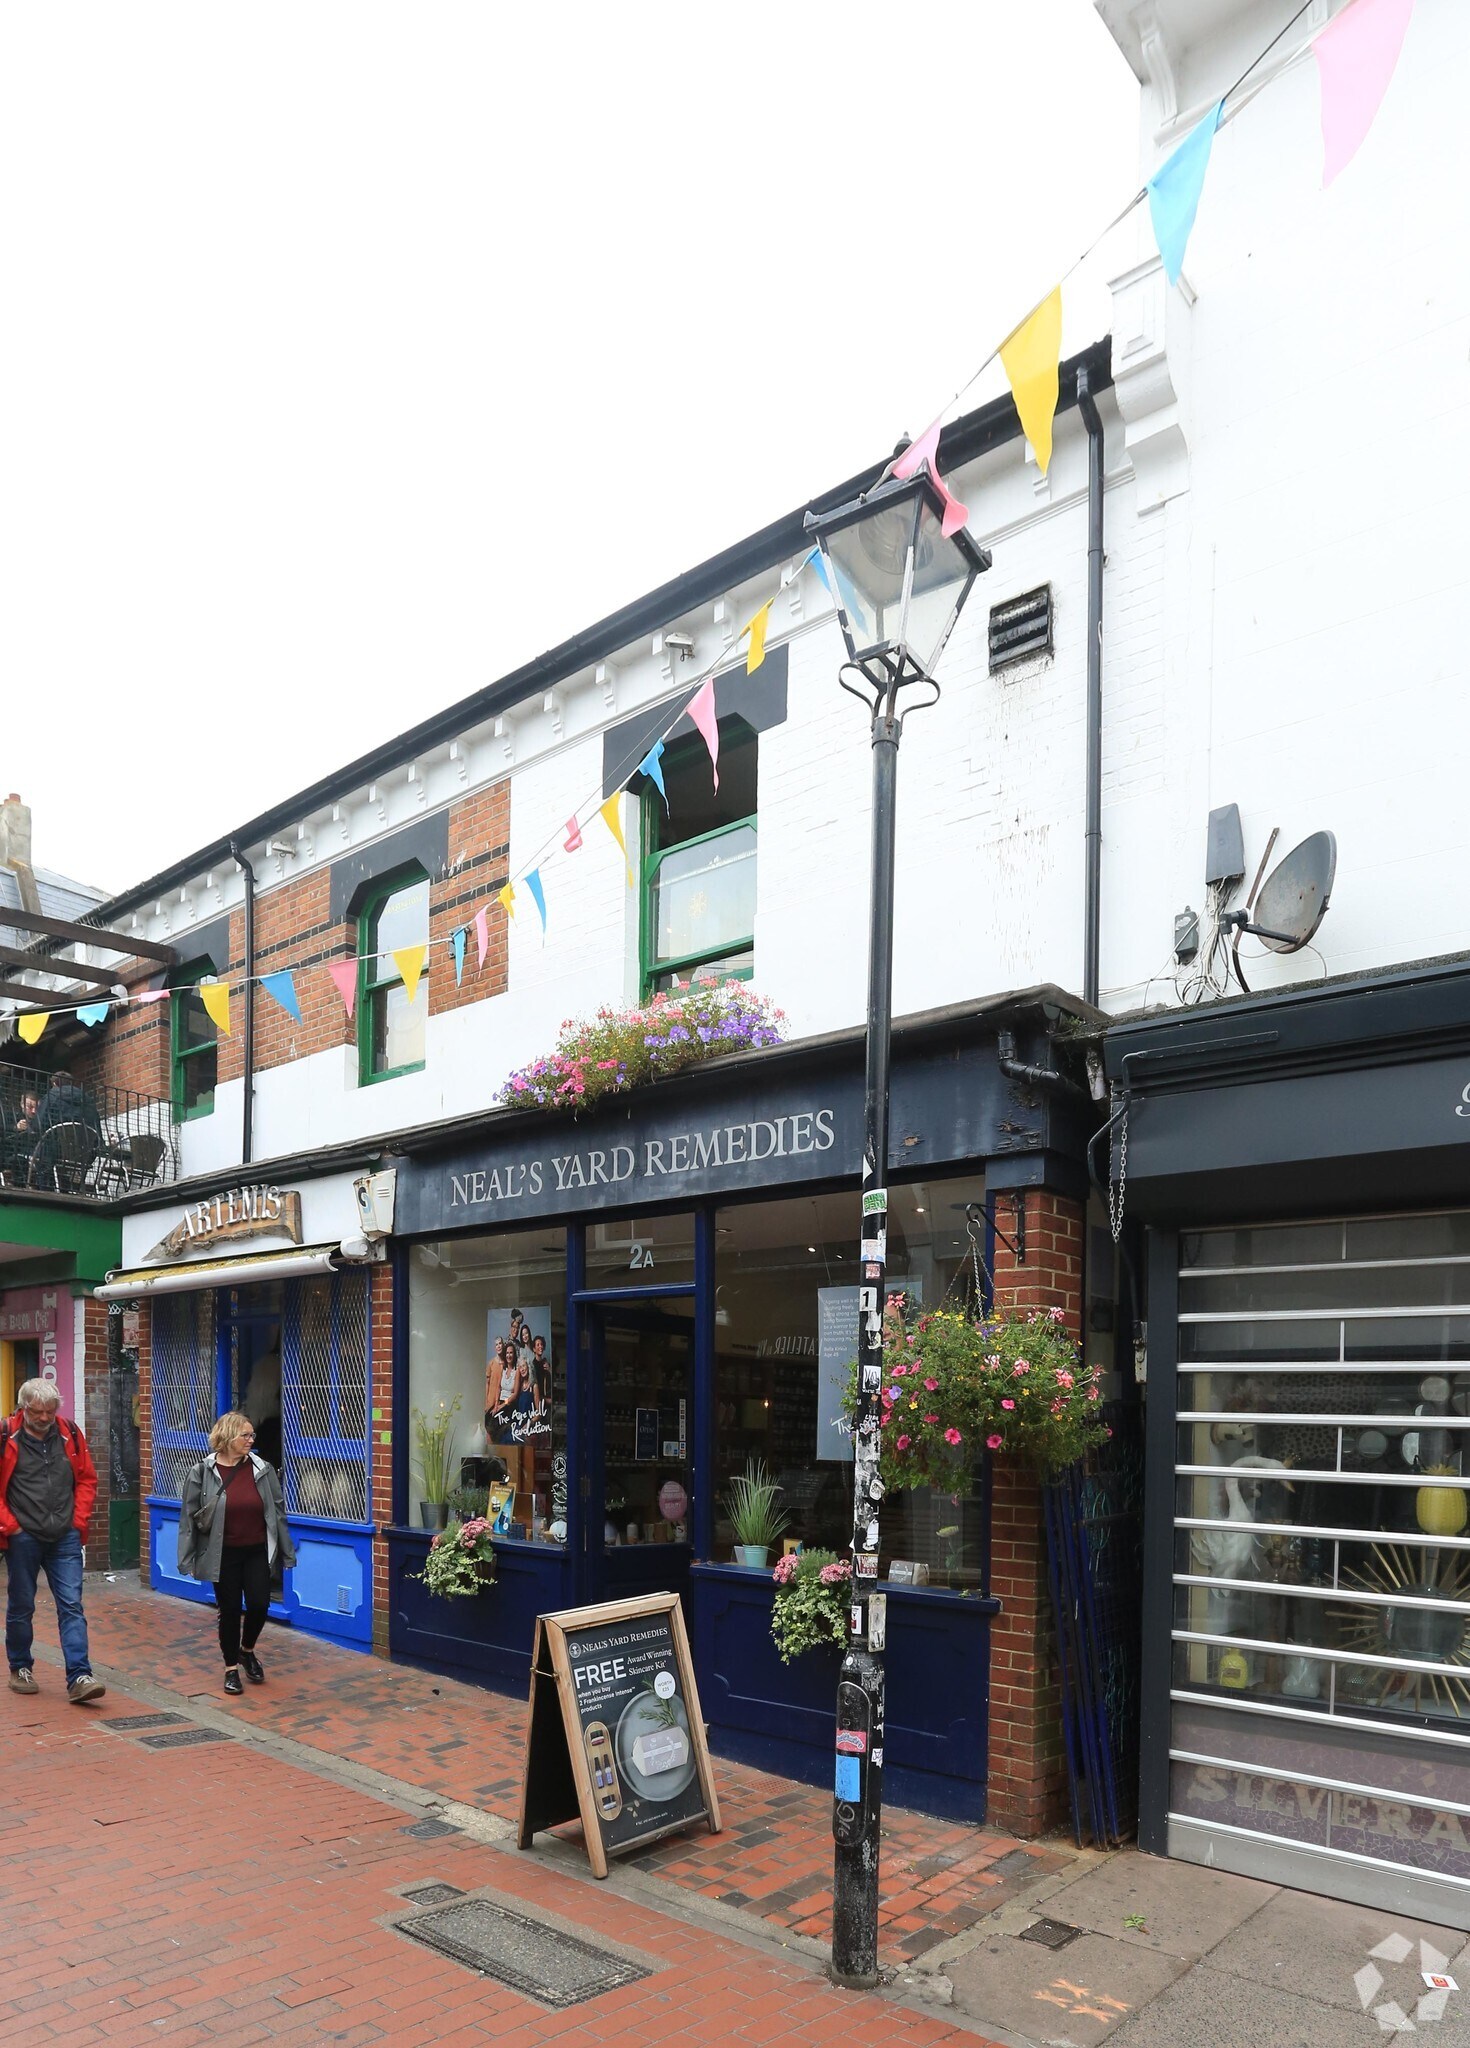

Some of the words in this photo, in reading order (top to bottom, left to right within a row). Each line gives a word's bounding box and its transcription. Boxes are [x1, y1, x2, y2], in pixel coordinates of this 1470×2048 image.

[451, 1161, 543, 1206] NEAL'S
[551, 1146, 635, 1191] YARD
[644, 1109, 834, 1177] REMEDIES
[178, 1184, 281, 1241] ARTEMIS
[629, 1244, 655, 1269] 2A
[494, 1410, 509, 1426] The
[511, 1409, 527, 1426] Age
[831, 1416, 854, 1435] The
[511, 1418, 552, 1442] Revolution
[582, 1640, 608, 1653] NEAL'S
[609, 1635, 629, 1647] YARD
[630, 1627, 668, 1642] REMEDIES
[627, 1655, 646, 1665] Award
[646, 1648, 672, 1660] Winning
[574, 1658, 627, 1689] FREE
[628, 1664, 654, 1676] Skincare
[578, 1691, 591, 1699] when
[592, 1689, 601, 1697] you
[602, 1686, 611, 1695] buy
[584, 1693, 615, 1705] Frankincense
[580, 1703, 602, 1715] products
